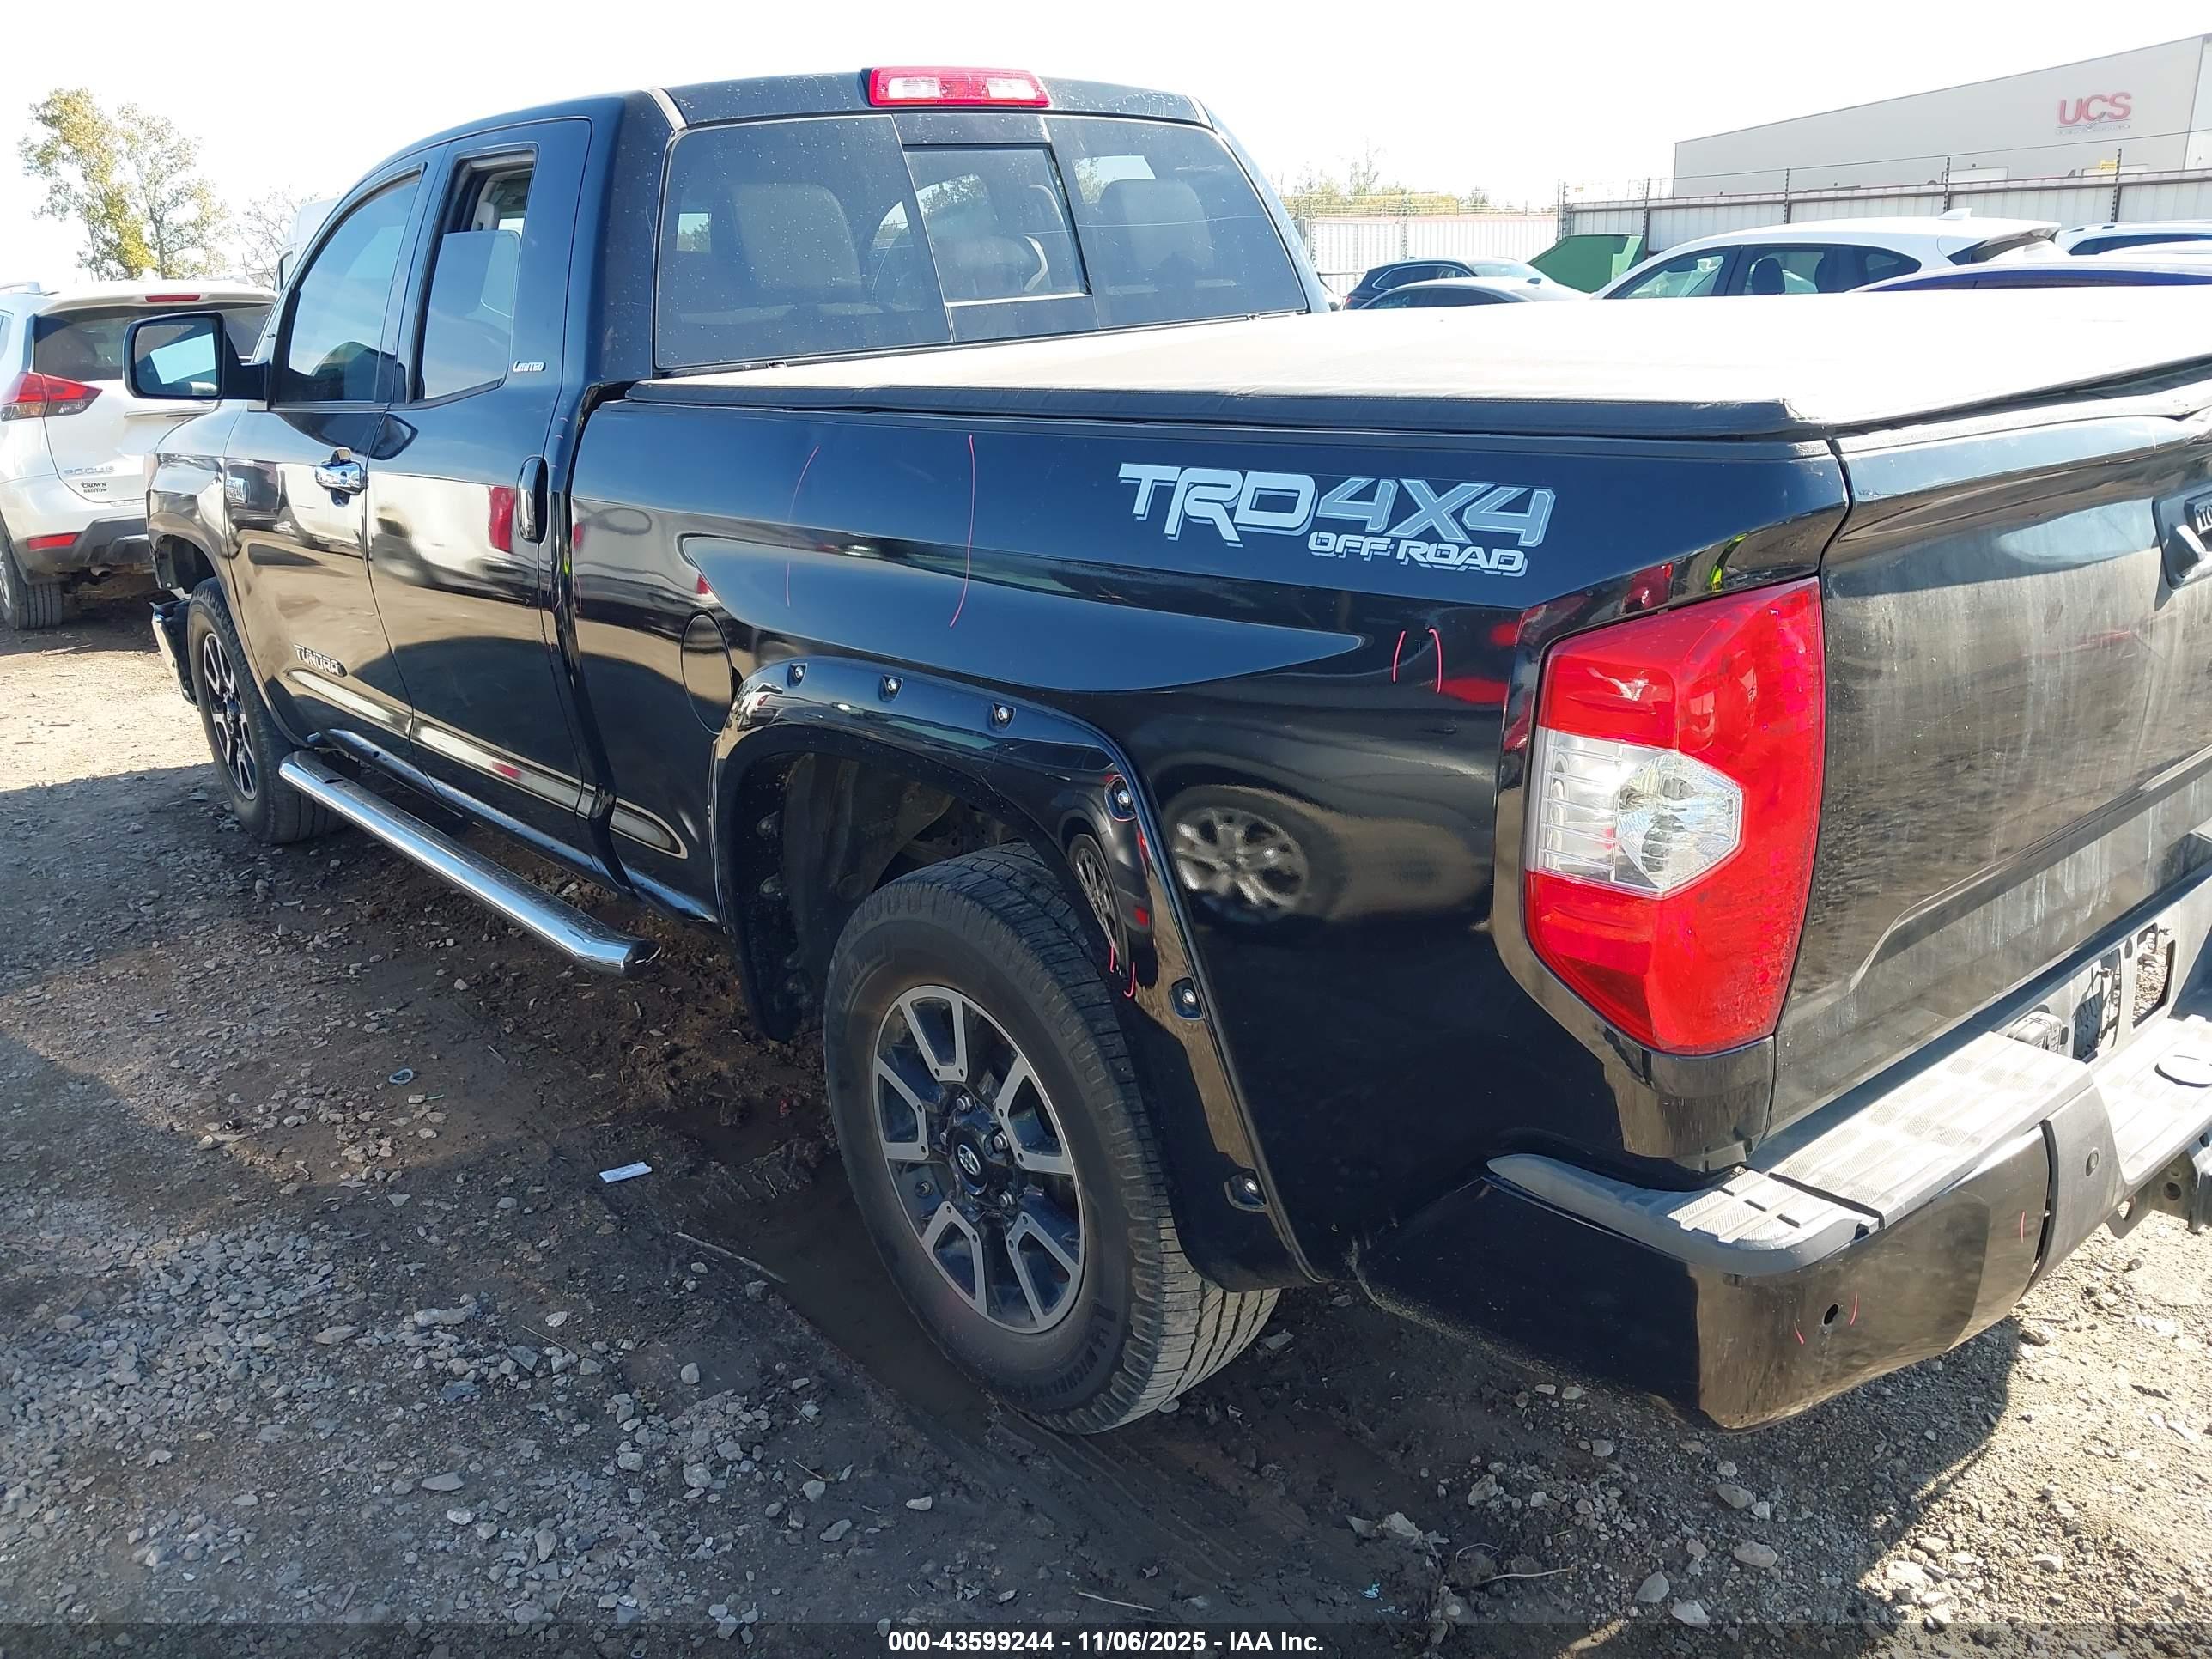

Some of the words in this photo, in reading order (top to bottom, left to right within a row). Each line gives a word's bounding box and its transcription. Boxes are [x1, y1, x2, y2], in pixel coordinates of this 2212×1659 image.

[2058, 91, 2132, 125] UCS
[1118, 463, 1318, 548] TRD
[1308, 530, 1394, 561] OFF
[1396, 539, 1528, 578] ROAD
[293, 643, 340, 676] TUNDRA
